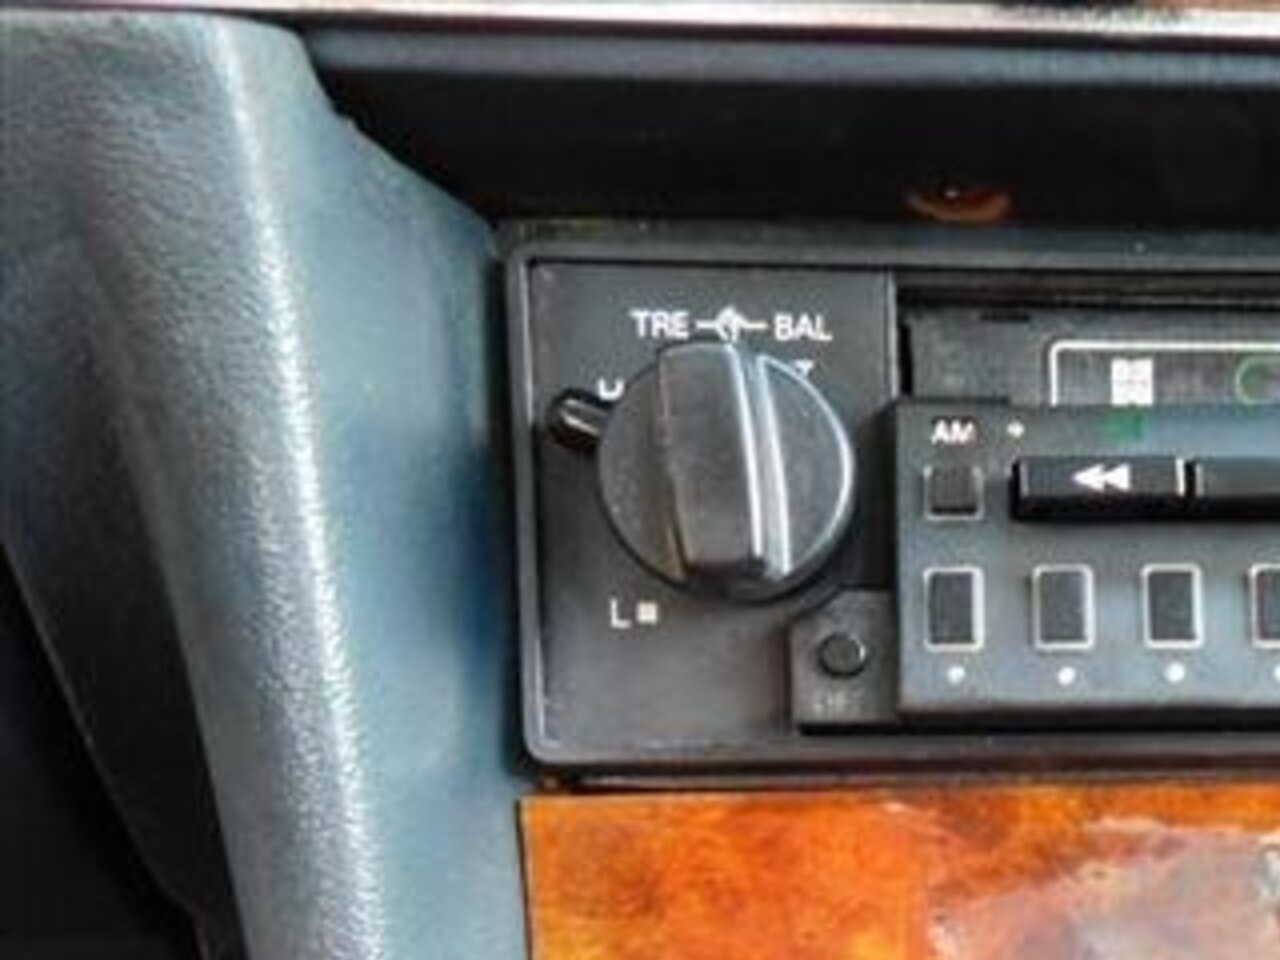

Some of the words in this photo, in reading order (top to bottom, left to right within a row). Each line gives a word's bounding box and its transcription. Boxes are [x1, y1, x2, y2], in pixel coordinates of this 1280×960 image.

[629, 309, 690, 338] TRE
[774, 312, 833, 341] BAL
[609, 599, 632, 629] L
